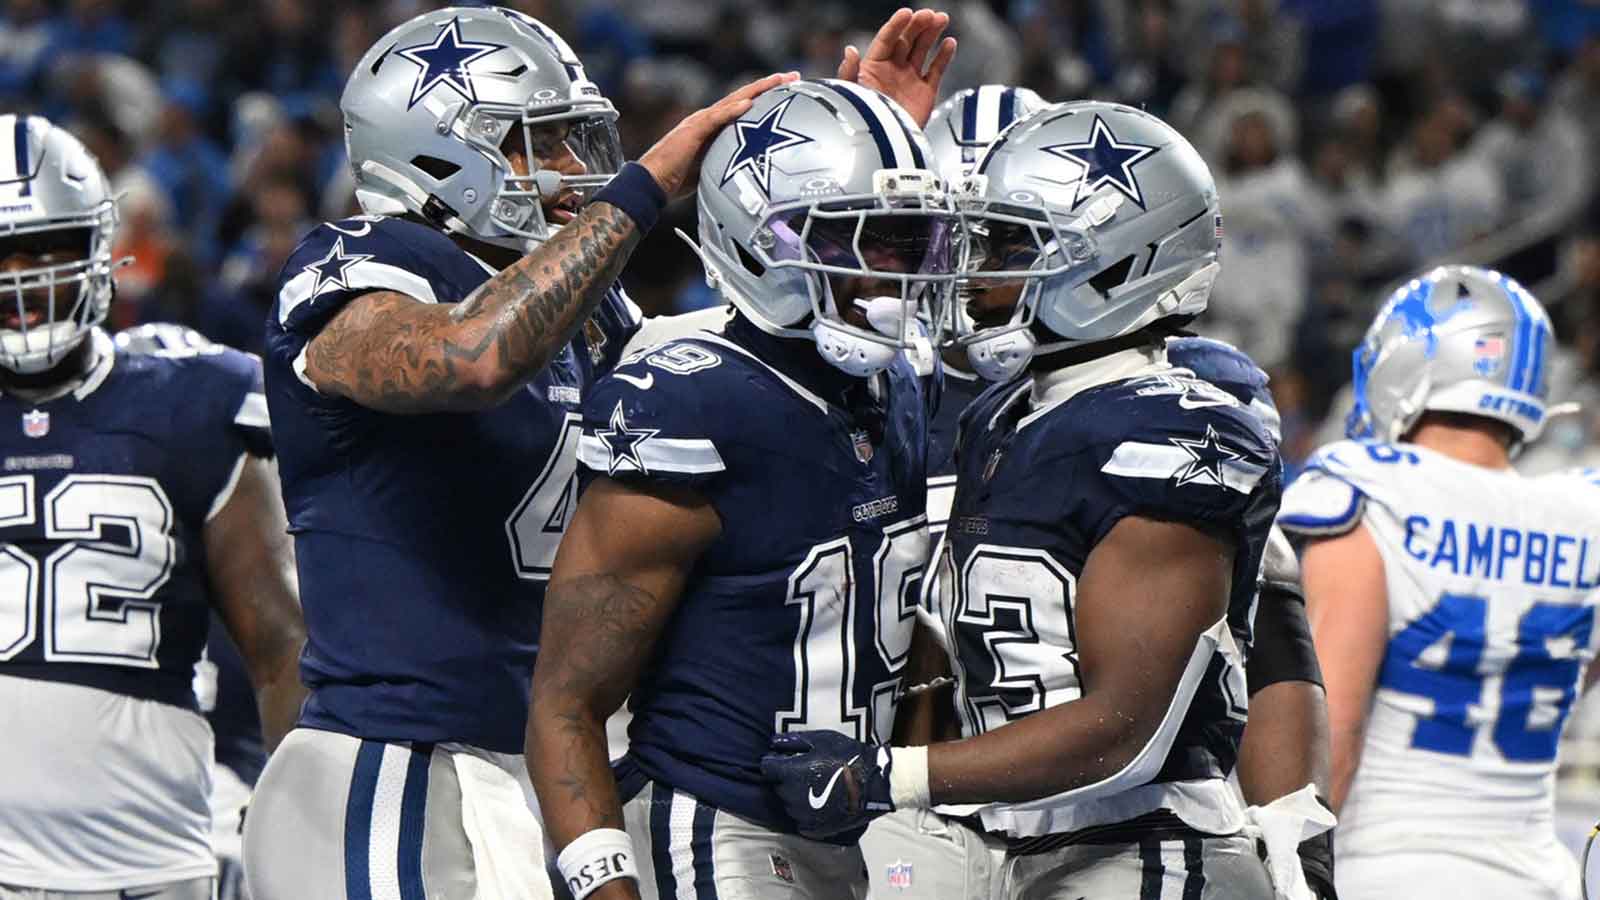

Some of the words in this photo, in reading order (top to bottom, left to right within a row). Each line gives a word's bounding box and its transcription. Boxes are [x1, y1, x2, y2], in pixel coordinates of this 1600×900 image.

[0, 473, 176, 670] 2
[505, 411, 584, 580] 4
[937, 543, 1084, 740] 3
[1377, 590, 1597, 764] 46
